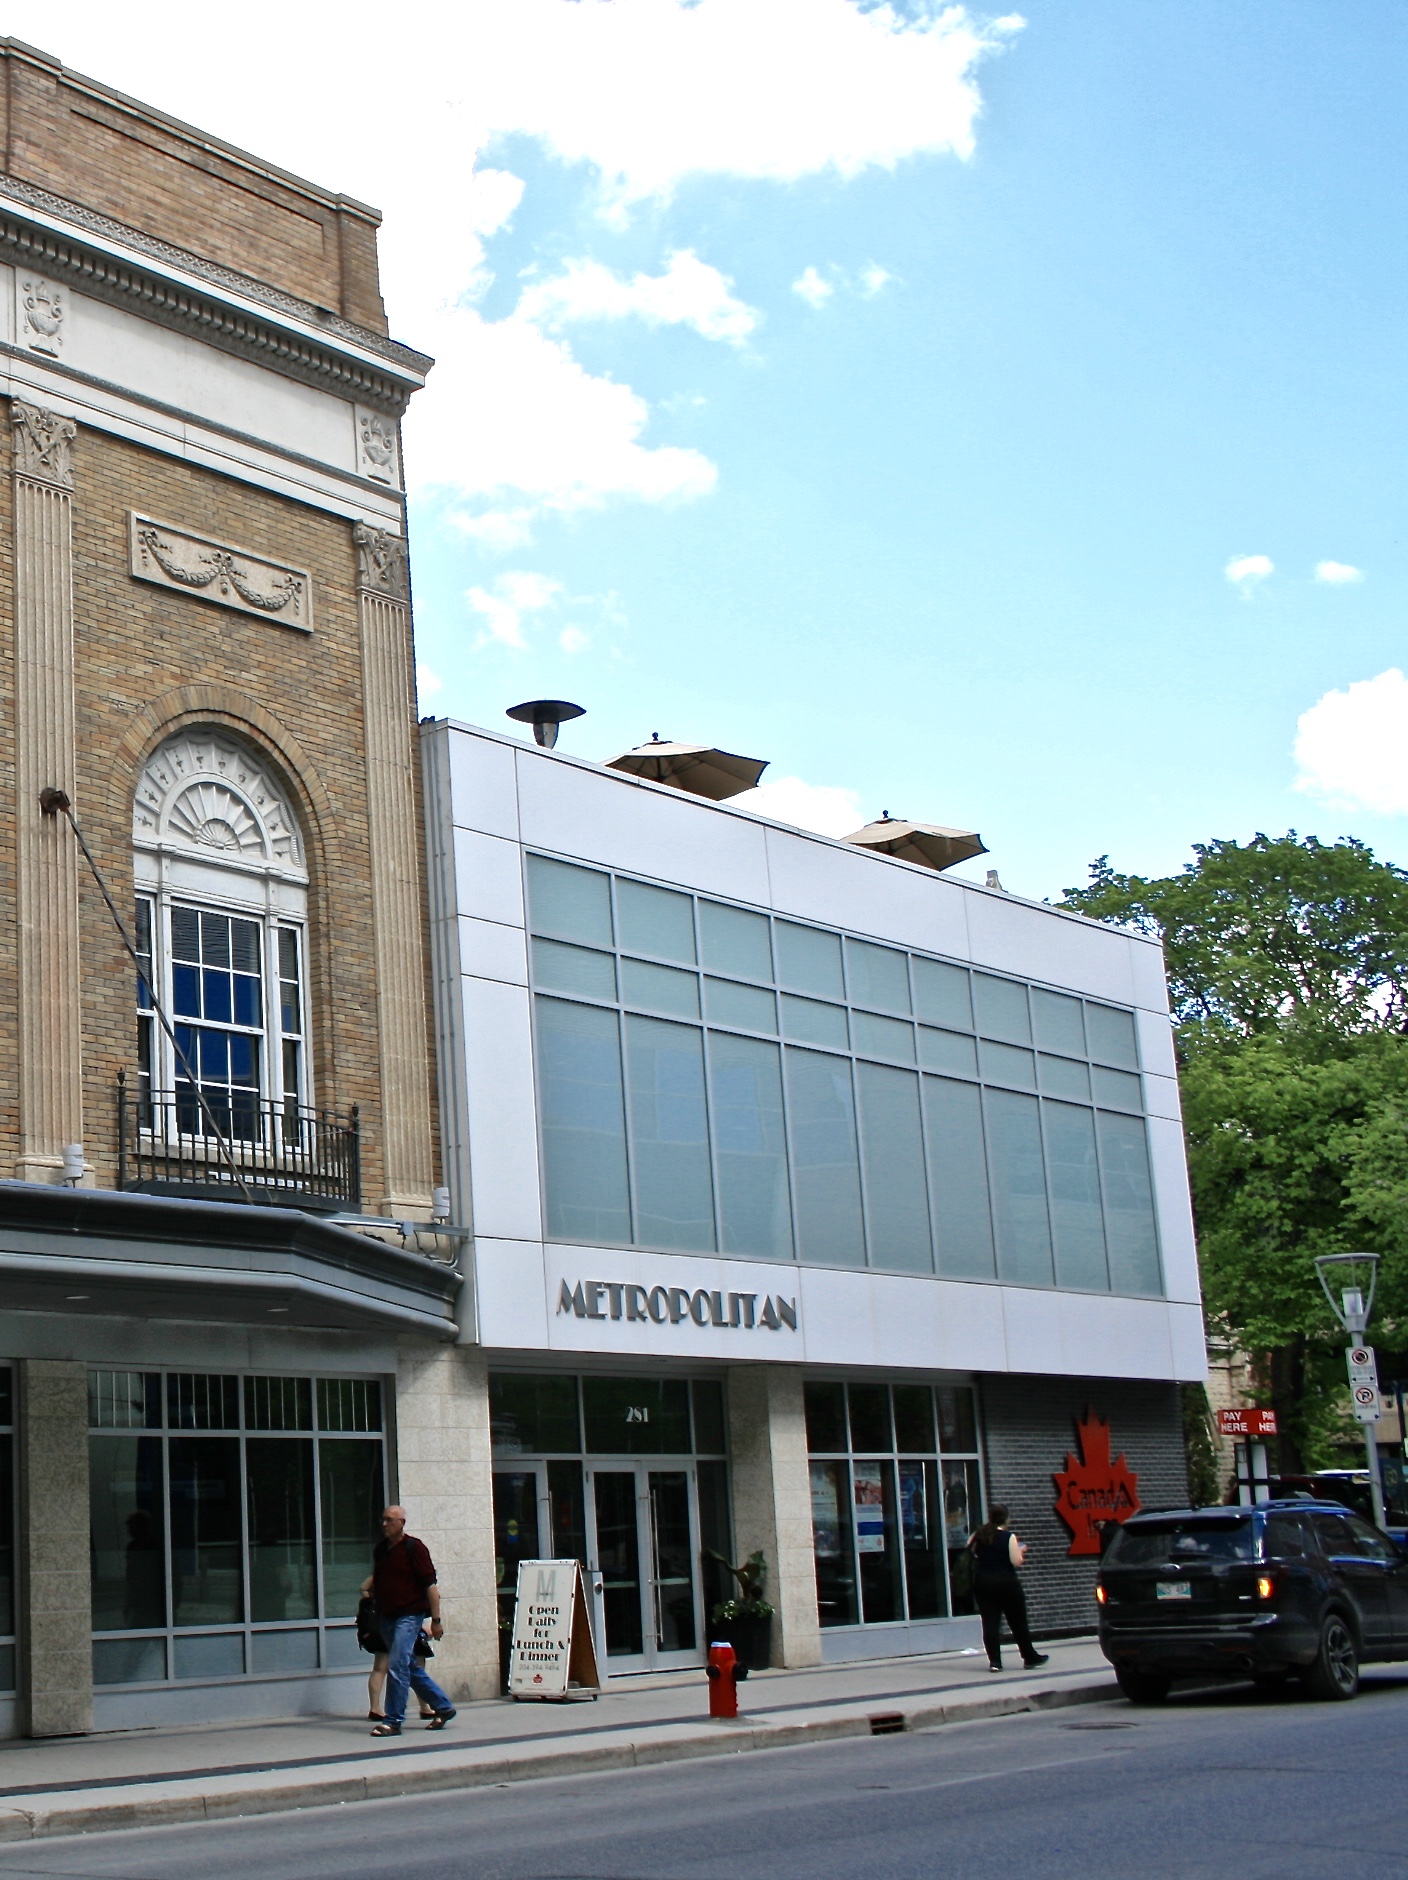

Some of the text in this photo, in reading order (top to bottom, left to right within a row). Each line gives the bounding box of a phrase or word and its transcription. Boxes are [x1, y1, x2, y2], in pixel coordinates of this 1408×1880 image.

[556, 1278, 797, 1331] METROPOLITAN
[625, 1406, 649, 1423] 281
[1223, 1411, 1241, 1421] PAY
[1221, 1422, 1248, 1432] HERE
[535, 1569, 557, 1603] M
[528, 1605, 559, 1616] Open
[528, 1617, 557, 1627] Daily
[533, 1628, 550, 1638] for
[516, 1640, 565, 1650] Lunch &
[519, 1651, 560, 1662] Dinner
